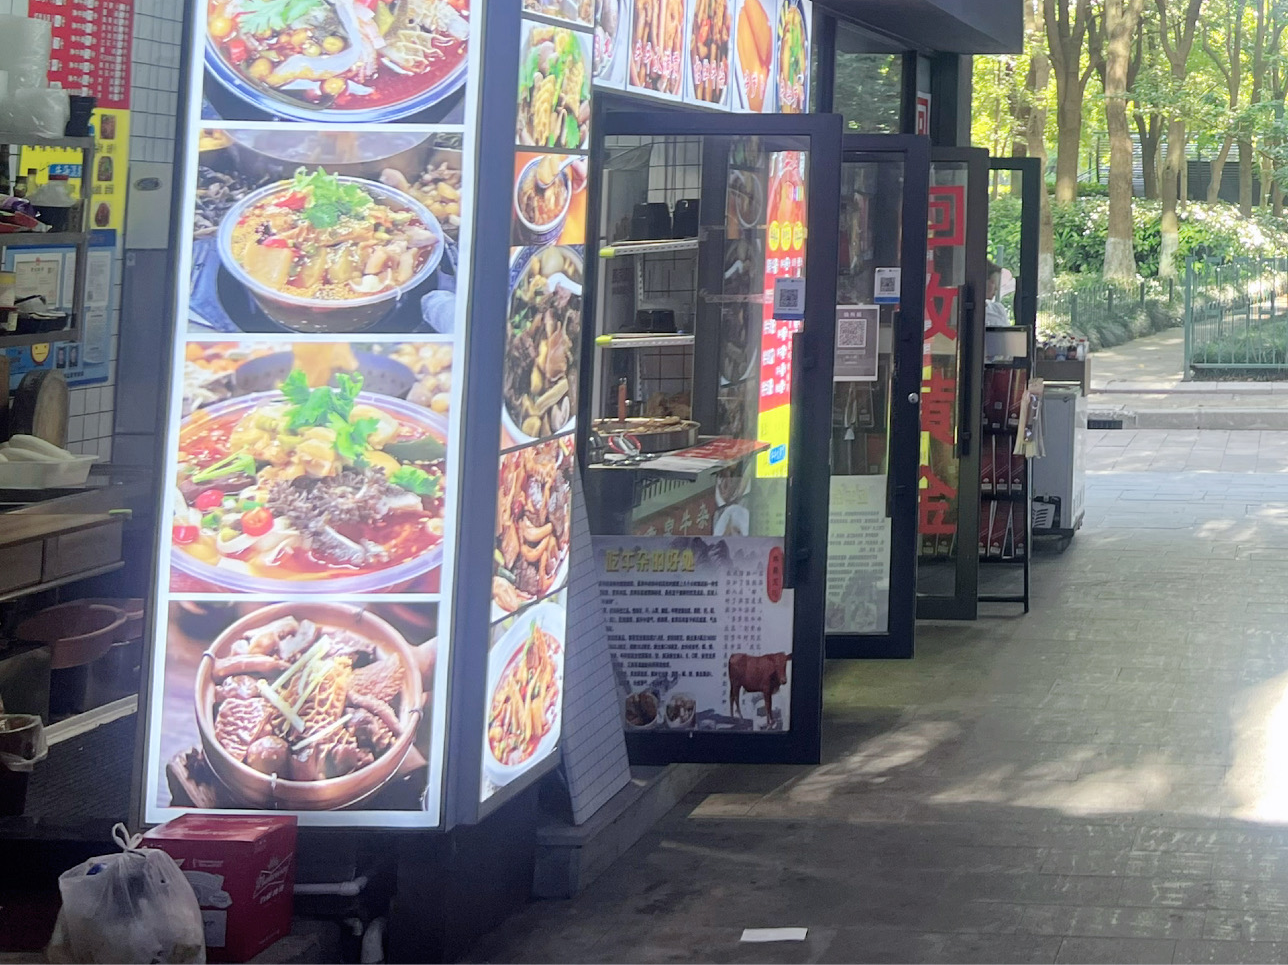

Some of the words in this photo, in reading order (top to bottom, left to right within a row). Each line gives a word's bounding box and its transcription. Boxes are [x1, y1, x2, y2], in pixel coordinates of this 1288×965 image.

[606, 548, 696, 573] 吃牛杂的好处
